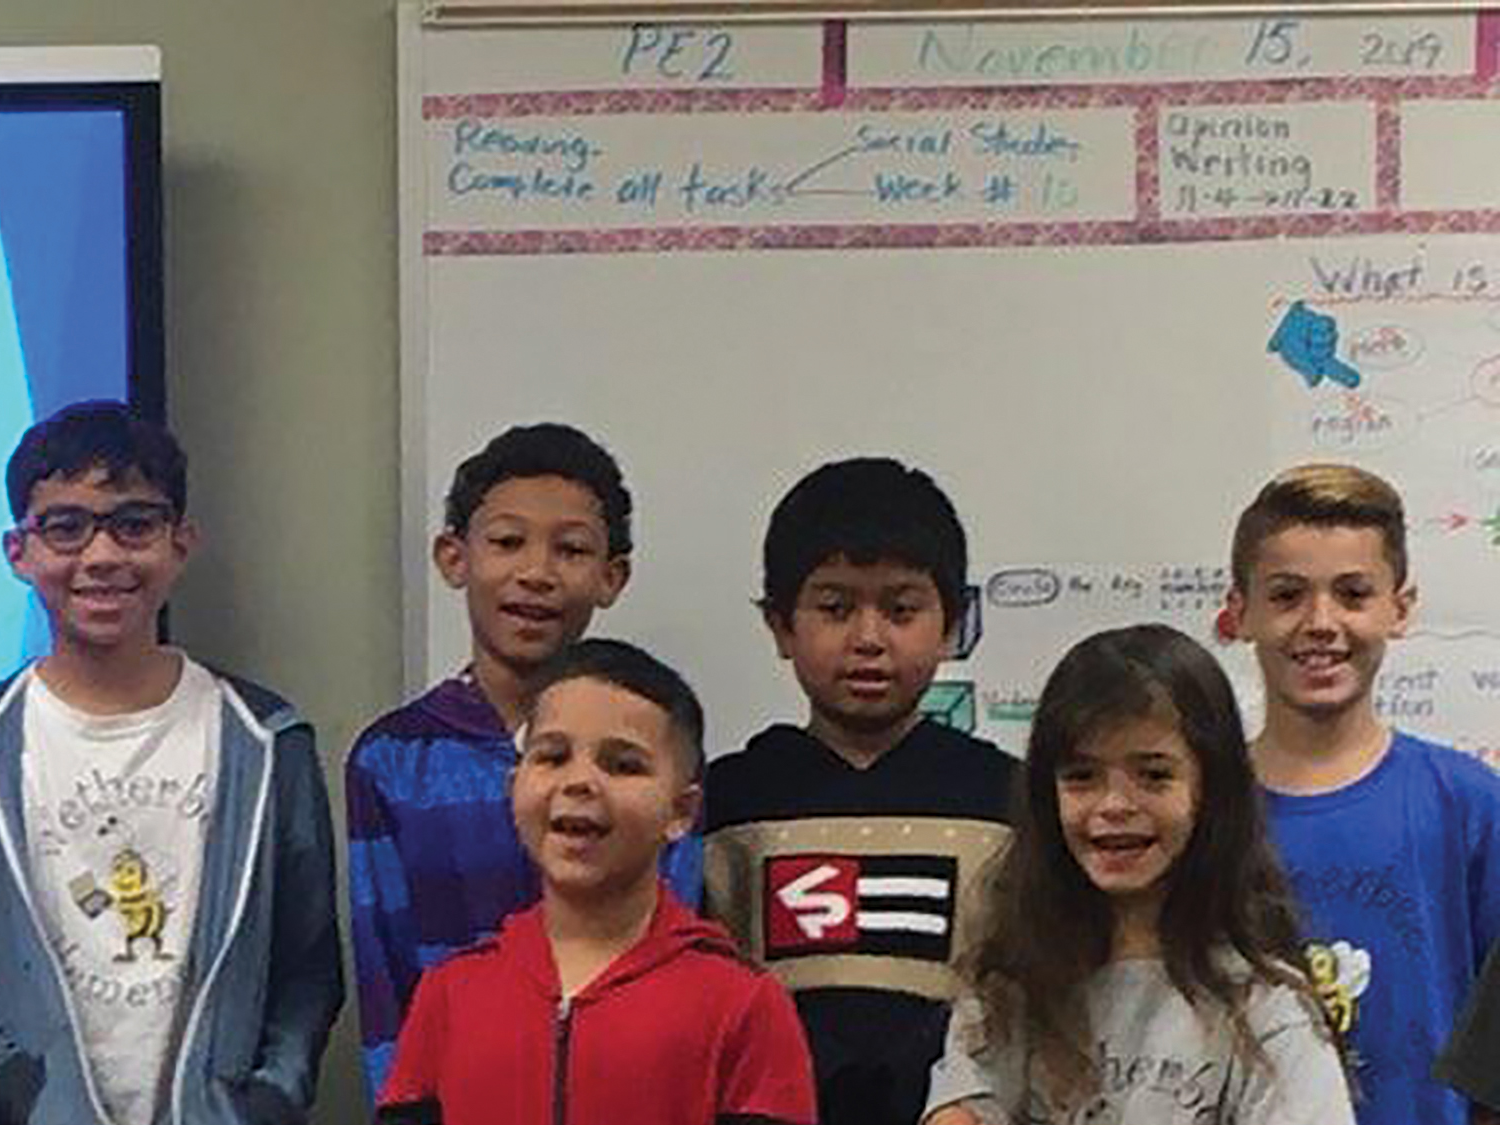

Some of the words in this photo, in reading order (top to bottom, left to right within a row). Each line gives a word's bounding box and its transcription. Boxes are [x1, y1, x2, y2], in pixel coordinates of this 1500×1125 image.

[856, 123, 952, 155] Social
[448, 162, 594, 199] Complete
[616, 171, 662, 207] all
[874, 171, 961, 202] Week
[984, 173, 1014, 204] #
[1170, 143, 1311, 192] Writing
[1308, 255, 1423, 297] What
[1452, 264, 1488, 294] is
